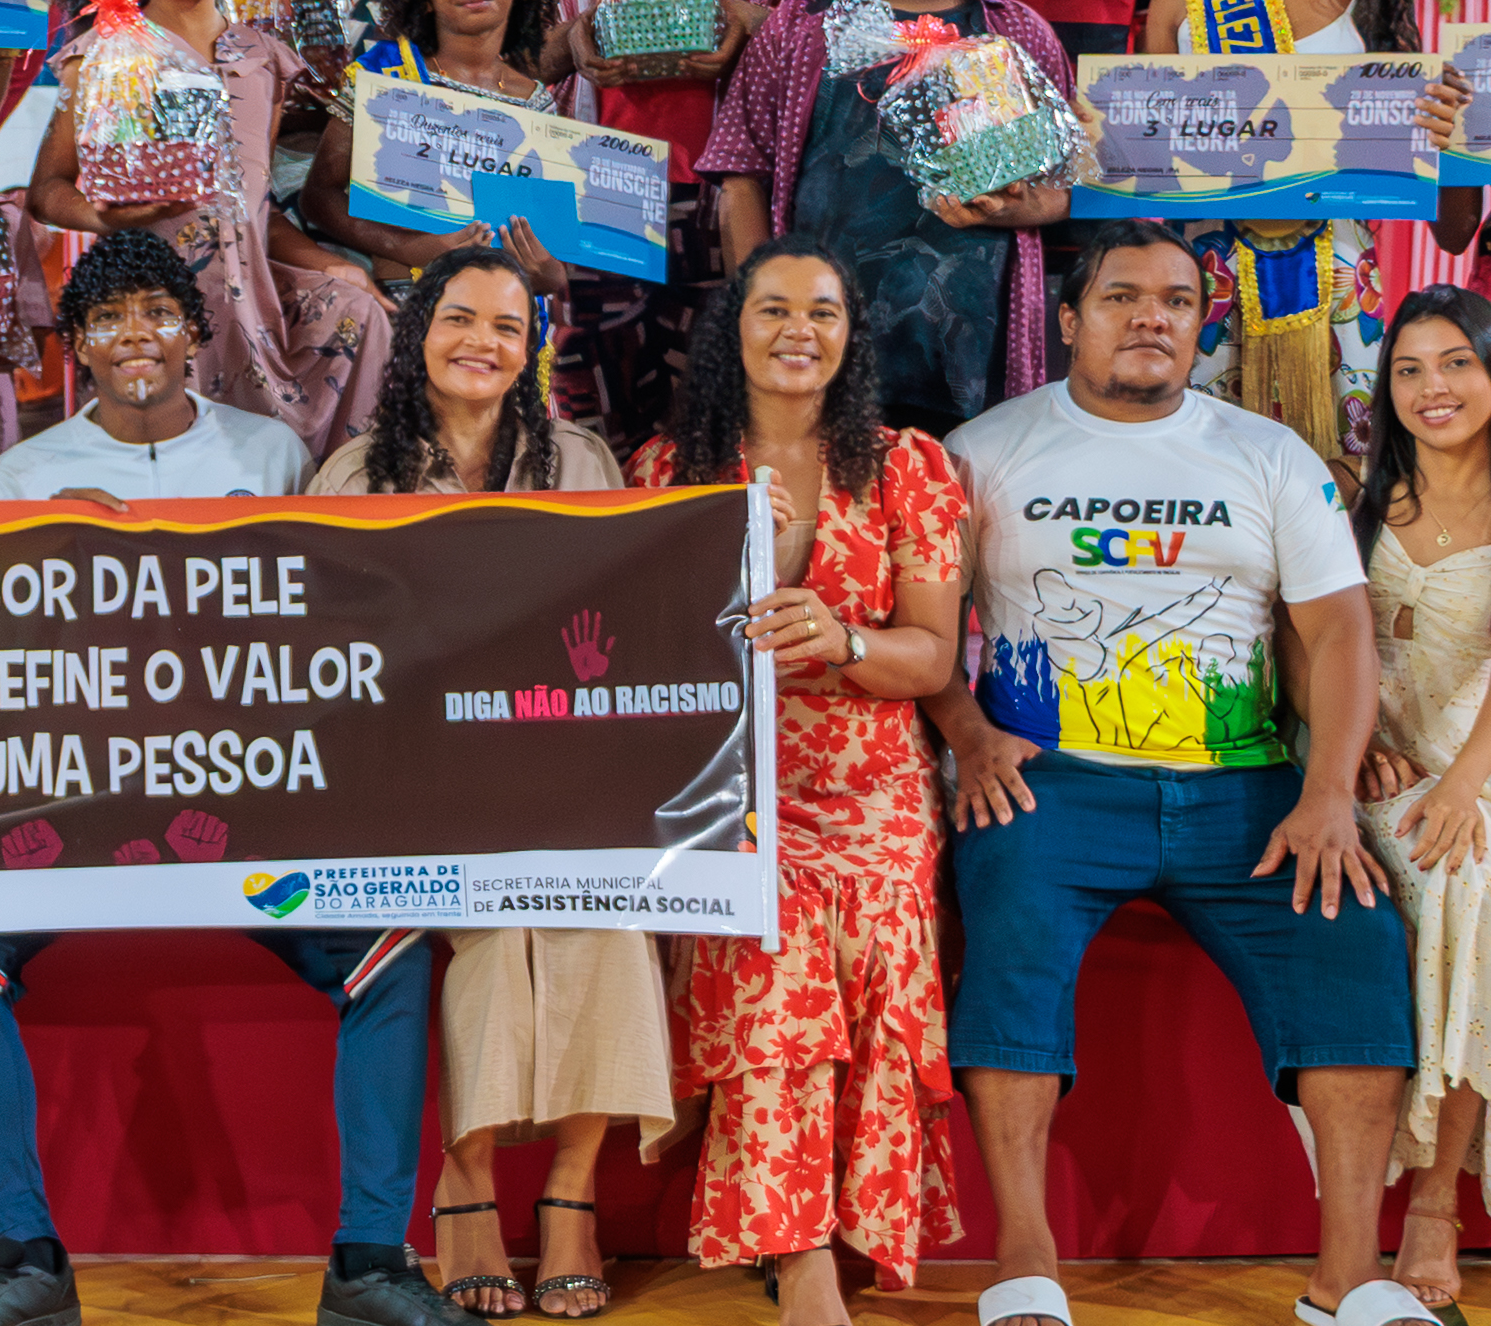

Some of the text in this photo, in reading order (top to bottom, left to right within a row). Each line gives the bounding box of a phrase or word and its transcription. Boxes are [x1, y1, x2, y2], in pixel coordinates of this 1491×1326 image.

[1180, 119, 1279, 138] LUGAR
[599, 135, 653, 157] 200,00
[448, 149, 533, 178] LUGAR
[1023, 496, 1232, 527] CAPOEIRA
[1070, 527, 1187, 567] SCFV
[92, 553, 171, 619] DA
[184, 554, 308, 619] PELE
[144, 648, 184, 704] O
[200, 640, 386, 707] VALOR
[445, 681, 741, 721] DIGA NÃO AO RACISMO
[107, 727, 328, 797] PESSOA
[313, 865, 461, 880] PREFEITURA DE
[472, 876, 664, 892] SECRETARIA MUNICIPAL
[314, 879, 461, 897] SÃO GERALDO
[314, 894, 462, 910] DO ARAGUAIA
[473, 889, 736, 916] DE ASSISTÊNCIA SOCIAL
